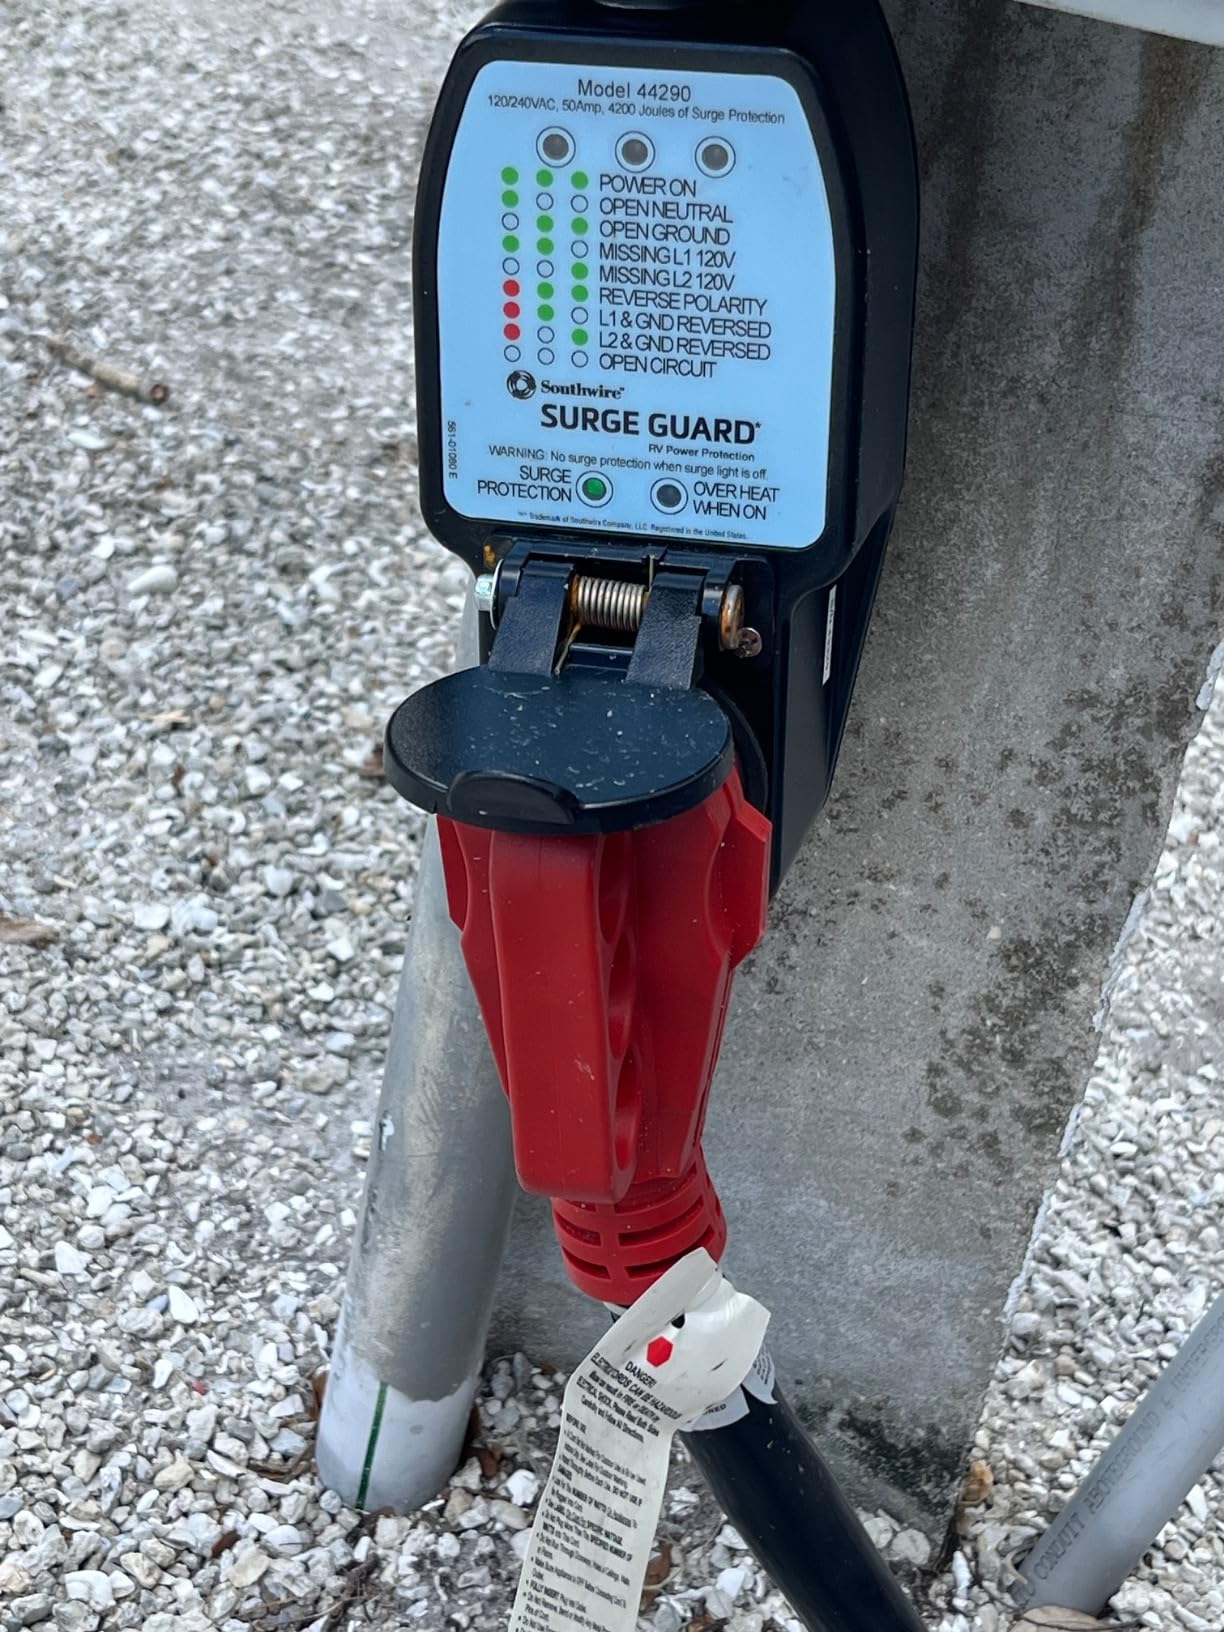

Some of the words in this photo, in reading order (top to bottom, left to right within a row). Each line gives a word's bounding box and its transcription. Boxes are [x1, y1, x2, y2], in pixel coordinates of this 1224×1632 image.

[578, 79, 630, 98] Model
[637, 82, 691, 102] 44290
[488, 95, 559, 112] 120/240VAC,
[562, 100, 604, 115] 50Amp,
[608, 103, 635, 116] 4200
[639, 104, 675, 118] Joules
[678, 106, 688, 119] of
[692, 108, 725, 122] Surge
[729, 110, 785, 125] Protection
[600, 174, 665, 195] POWER
[669, 179, 696, 197] ON
[600, 197, 649, 217] OPEN
[652, 201, 733, 223] NEUTRAL
[600, 220, 648, 240] OPEN
[652, 224, 730, 245] GROUND
[600, 243, 670, 264] MISSING
[674, 249, 690, 265] L1
[697, 250, 735, 268] 120V
[600, 265, 670, 286] MISSING
[674, 271, 691, 288] L2
[696, 273, 735, 291] 120V
[600, 288, 680, 310] REVERSE
[684, 294, 767, 316] POLARITY
[600, 310, 616, 326] L1
[621, 311, 632, 327] &
[636, 312, 674, 331] GND
[677, 316, 771, 338] REVERSED
[600, 332, 617, 348] L2
[621, 333, 632, 350] &
[635, 334, 673, 352] GND
[677, 338, 770, 360] REVERSED
[600, 353, 647, 372] OPEN
[650, 357, 717, 378] CIRCUIT
[541, 403, 639, 435] SURGE
[551, 450, 566, 462] No
[568, 454, 597, 466] surge
[600, 456, 650, 470] protection
[654, 460, 682, 472] when
[684, 464, 714, 477] surge
[717, 466, 738, 479] light
[742, 468, 750, 478] is
[649, 444, 663, 453] RV
[666, 445, 698, 456] Power
[702, 448, 755, 462] Protection
[520, 464, 572, 484] SURGE
[478, 480, 572, 503] PROTECTION
[693, 500, 740, 517] WHEN
[743, 504, 766, 520] ON
